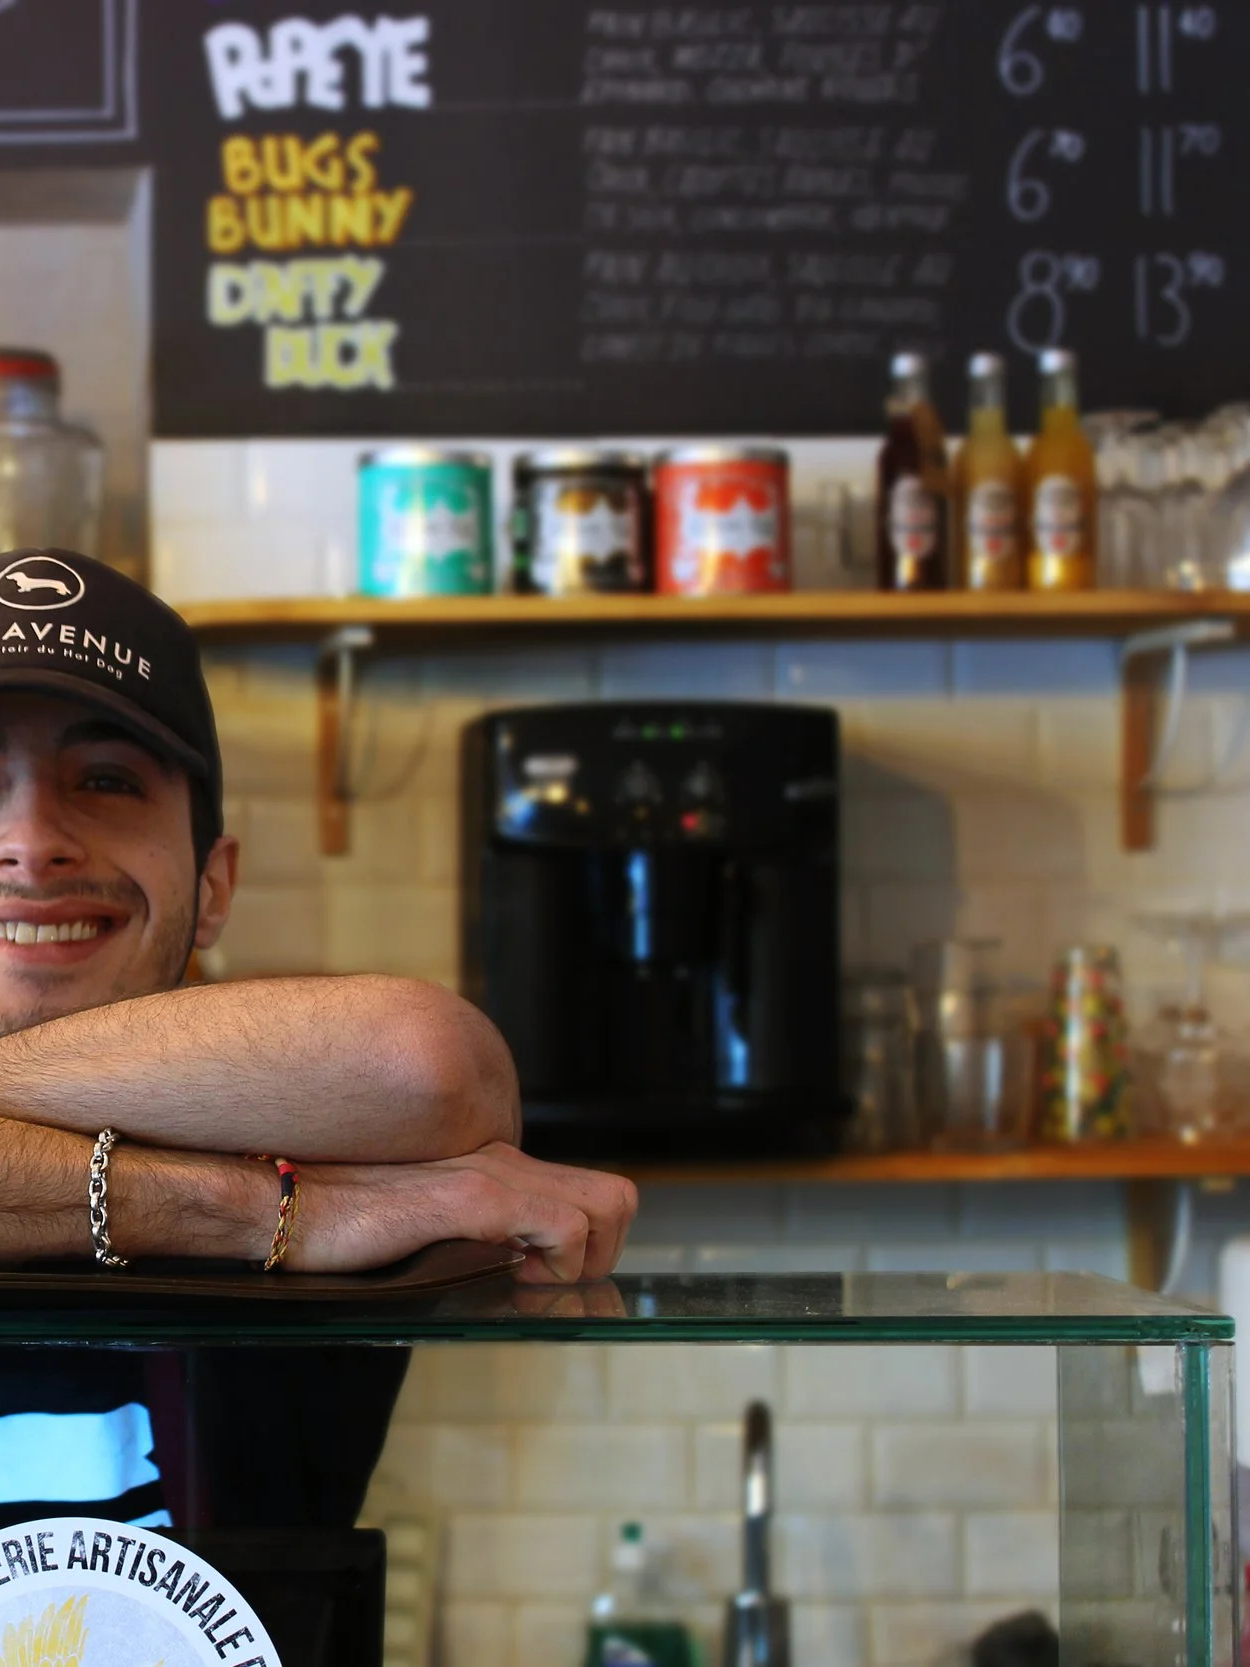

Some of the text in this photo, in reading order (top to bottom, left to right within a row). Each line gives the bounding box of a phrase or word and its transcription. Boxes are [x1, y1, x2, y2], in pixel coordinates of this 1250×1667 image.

[223, 131, 379, 194] BUGS
[208, 189, 412, 253] BUNNY
[265, 320, 398, 391] DUCK
[1, 621, 151, 680] AVENUE
[37, 644, 54, 655] du
[63, 648, 89, 662] Hot
[96, 657, 123, 680] Dog
[67, 1530, 255, 1660] ARTISANALE
